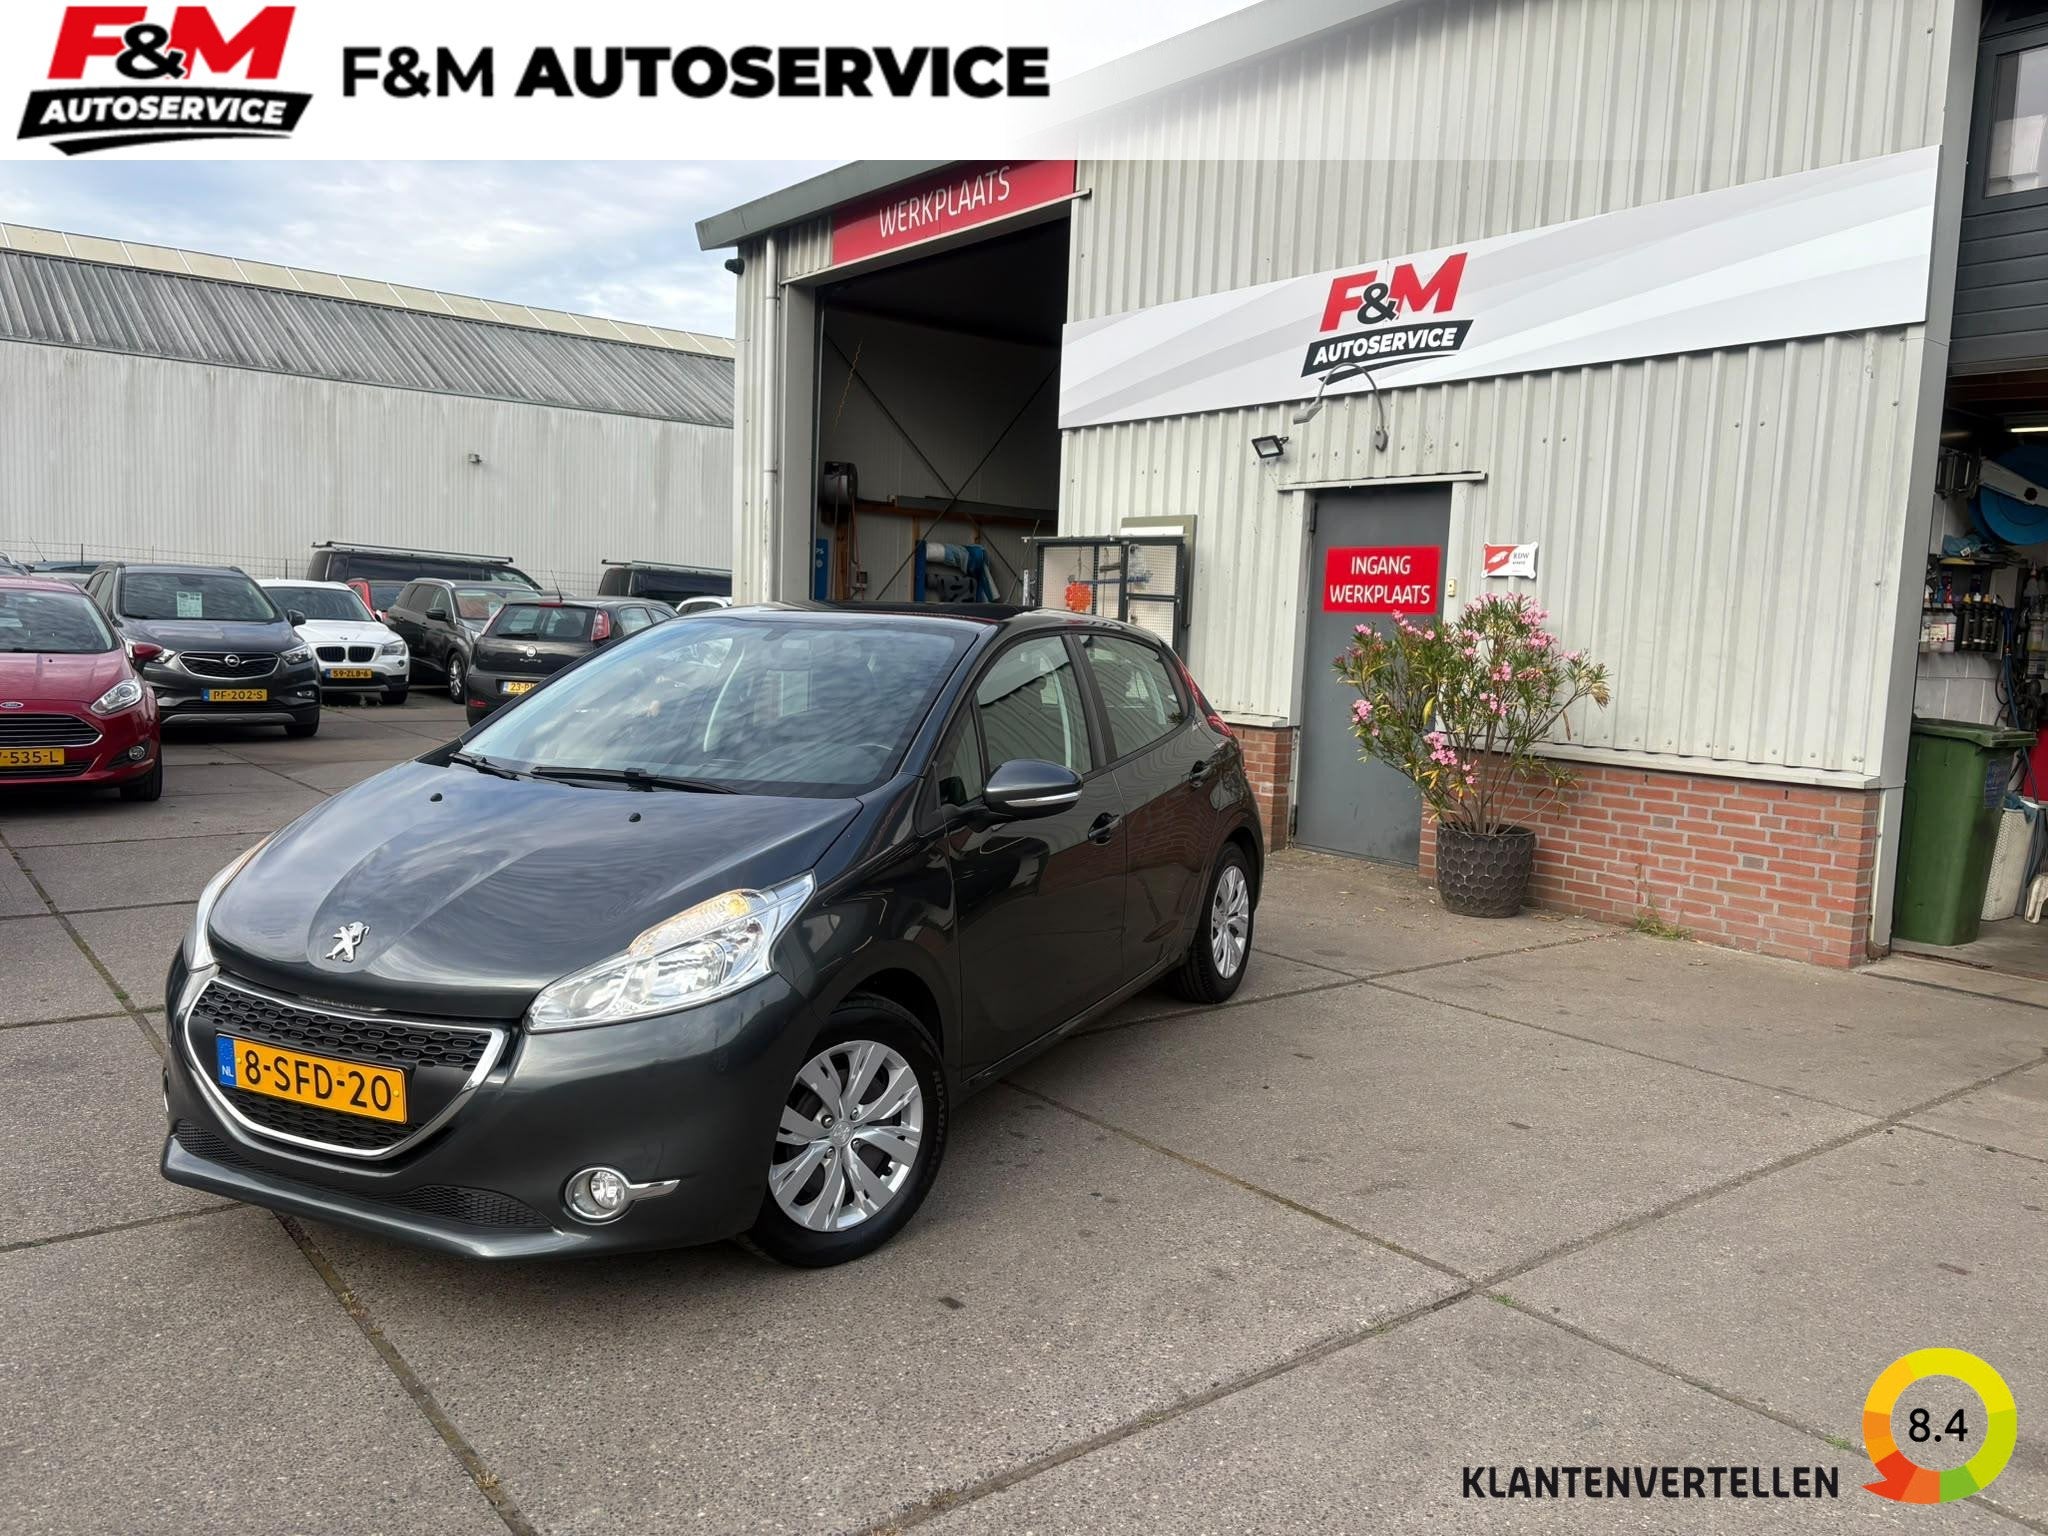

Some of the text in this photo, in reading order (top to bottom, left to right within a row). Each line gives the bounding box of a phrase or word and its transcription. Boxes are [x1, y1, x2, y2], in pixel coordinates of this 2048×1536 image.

[879, 165, 1011, 239] WERKPLAATS
[1319, 252, 1468, 333] F&M
[1313, 327, 1458, 367] AUTOSERVICE
[1350, 555, 1412, 576] INGANG
[1328, 584, 1431, 605] WERKPLAATS
[213, 690, 264, 700] PF-202-S
[0, 750, 59, 765] -535-L
[221, 1065, 235, 1079] NL
[244, 1049, 393, 1113] 8-SFD-20
